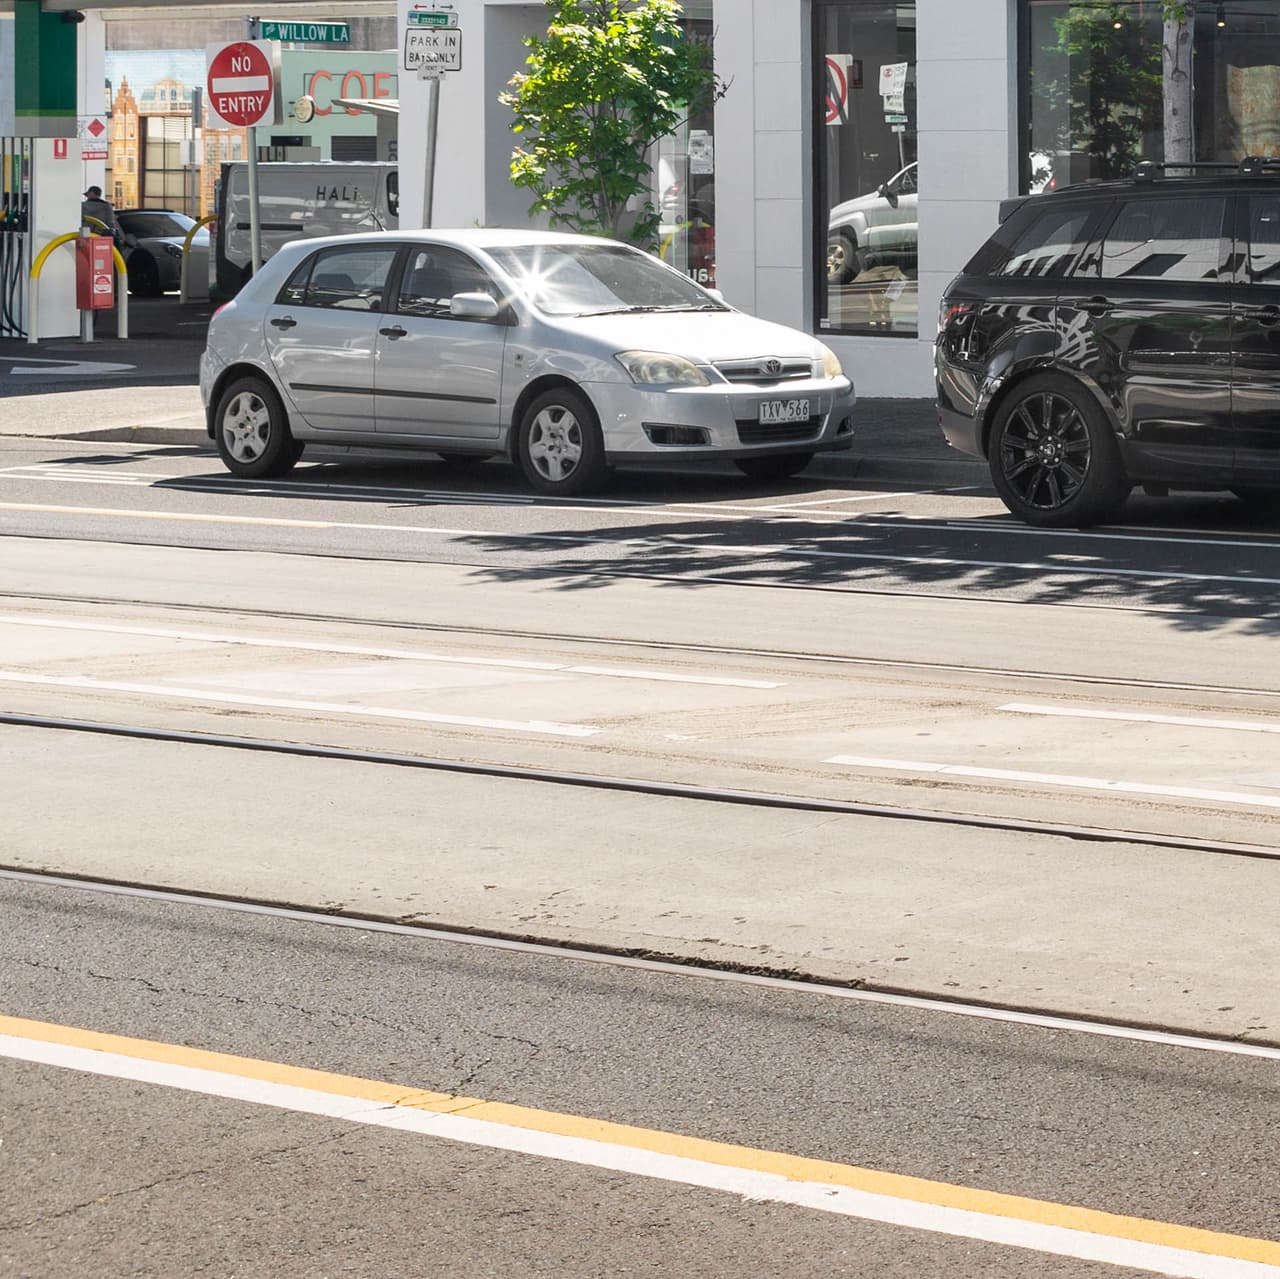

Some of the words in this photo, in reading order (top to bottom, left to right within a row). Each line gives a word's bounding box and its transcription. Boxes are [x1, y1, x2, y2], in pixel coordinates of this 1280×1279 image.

[278, 24, 329, 41] WILLOW
[332, 26, 348, 41] LA
[410, 36, 439, 46] PARK
[445, 36, 456, 46] IN
[232, 56, 251, 72] NO
[218, 96, 265, 113] ENTRY
[789, 401, 808, 417] 566
